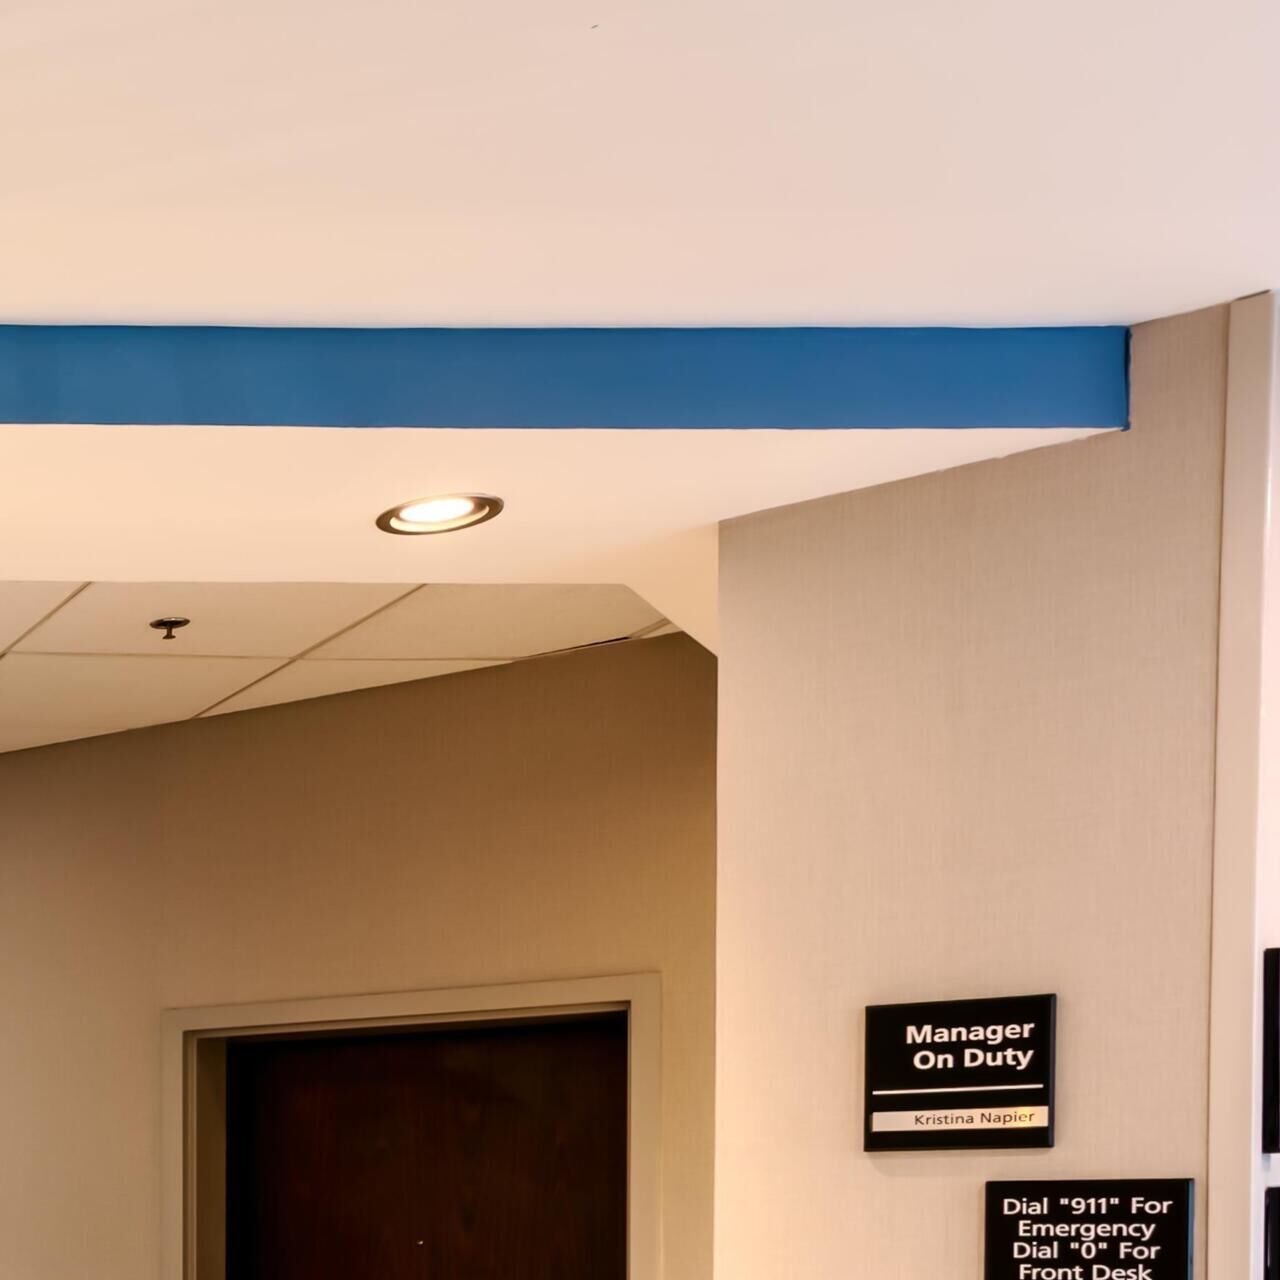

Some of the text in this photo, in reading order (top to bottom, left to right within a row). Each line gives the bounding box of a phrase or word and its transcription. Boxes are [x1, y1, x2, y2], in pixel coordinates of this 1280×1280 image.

[906, 1023, 1035, 1045] Manager
[913, 1048, 1034, 1070] On Duty
[914, 1111, 1035, 1126] Kristina Napier
[1003, 1197, 1173, 1215] Dial "911" For
[1018, 1220, 1156, 1241] Emergency
[1013, 1241, 1161, 1259] Dial "0" For
[1019, 1264, 1084, 1280] Front
